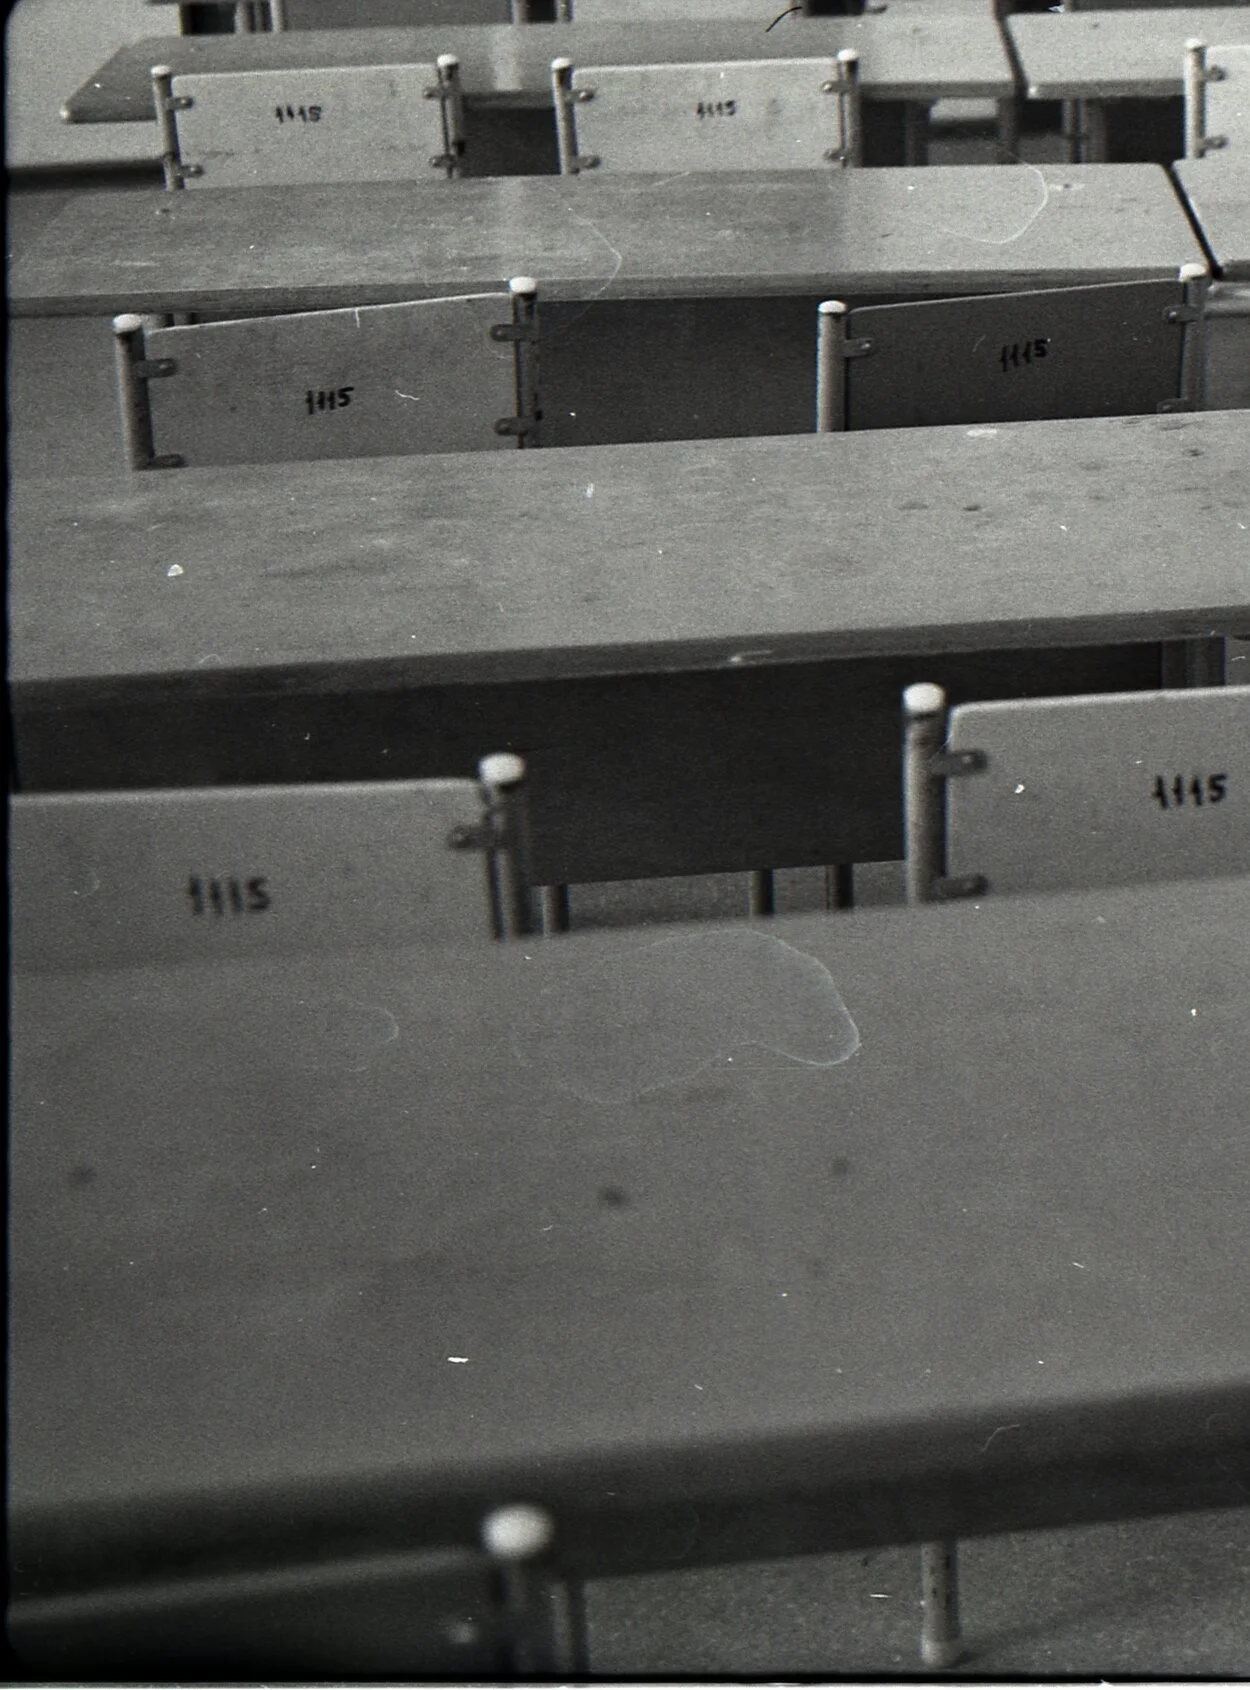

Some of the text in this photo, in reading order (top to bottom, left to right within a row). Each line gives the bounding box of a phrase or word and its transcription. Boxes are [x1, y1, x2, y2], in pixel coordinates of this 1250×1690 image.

[275, 104, 322, 124] 1115
[697, 100, 736, 119] 1115
[999, 339, 1048, 373] 1115
[305, 387, 354, 415] 1115
[1152, 773, 1227, 809] 1115
[187, 874, 271, 916] 1115
